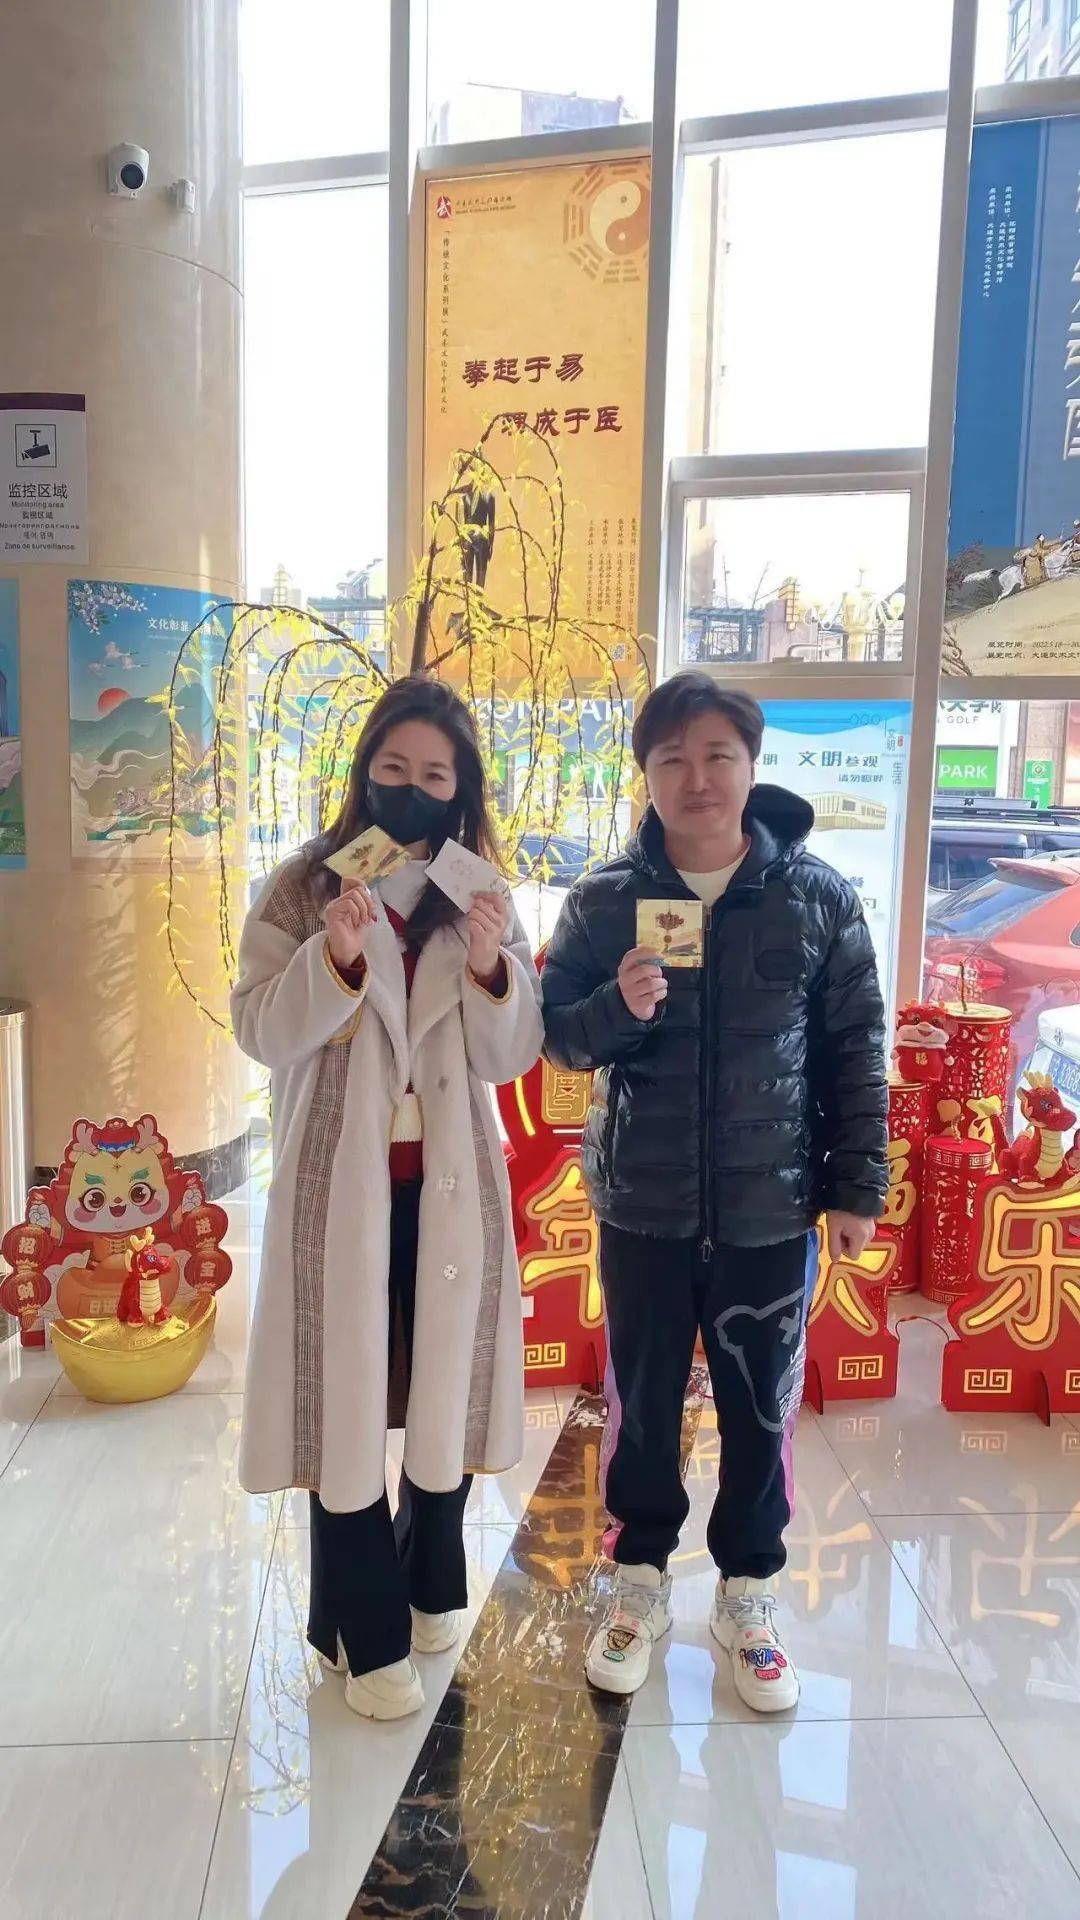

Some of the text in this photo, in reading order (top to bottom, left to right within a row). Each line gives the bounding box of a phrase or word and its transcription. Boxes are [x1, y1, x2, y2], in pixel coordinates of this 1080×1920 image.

[462, 354, 584, 389] 拳起于易
[8, 483, 68, 499] 监控区域
[798, 750, 879, 767] 文明参观
[939, 764, 989, 779] PARK
